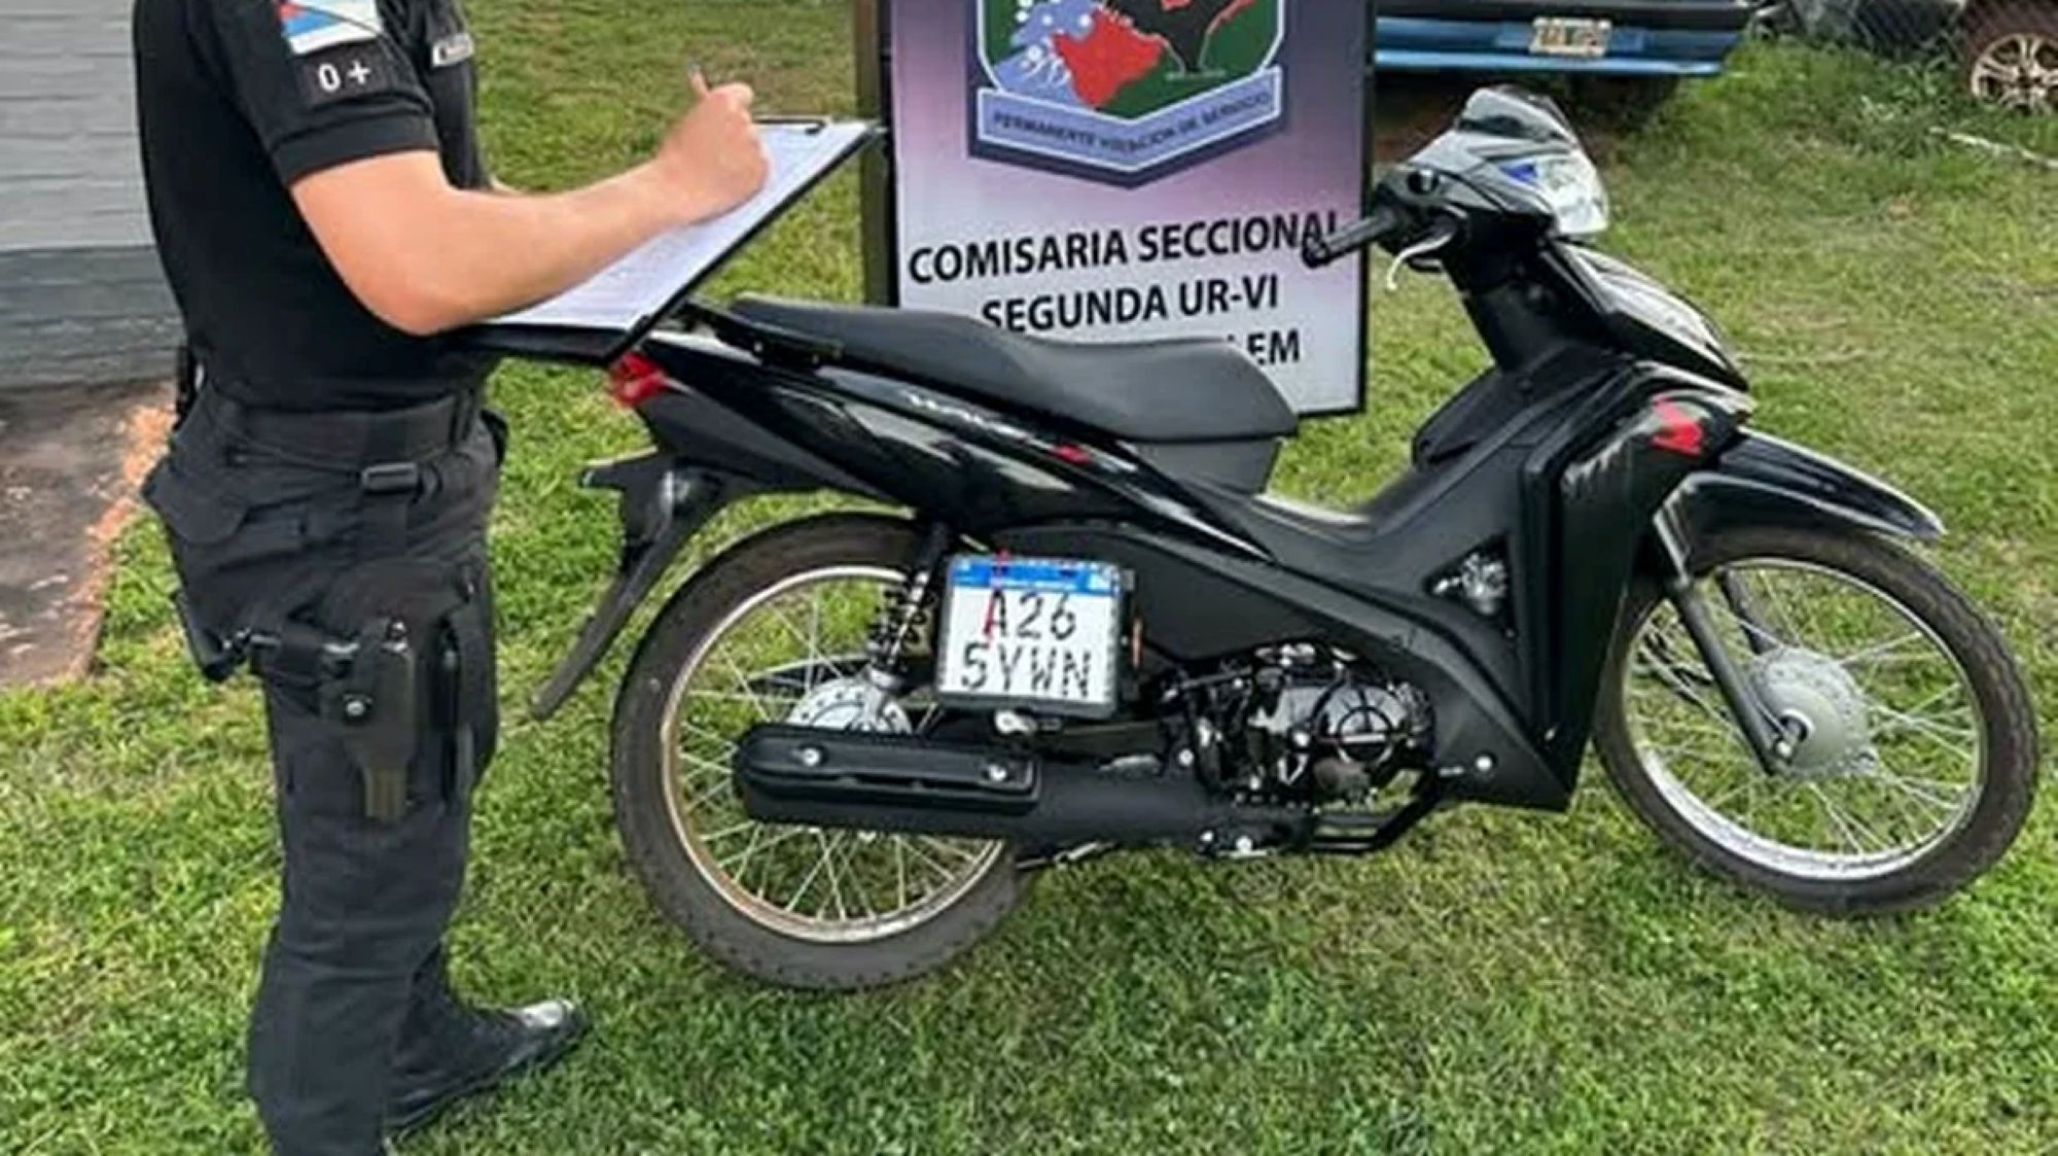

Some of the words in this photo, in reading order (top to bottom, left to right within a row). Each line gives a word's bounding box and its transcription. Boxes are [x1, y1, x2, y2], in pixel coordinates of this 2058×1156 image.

[908, 229, 1129, 284] COMISARIA
[981, 284, 1169, 333] SEGUNDA
[1179, 273, 1277, 316] UR-VI
[983, 588, 1076, 640] A26
